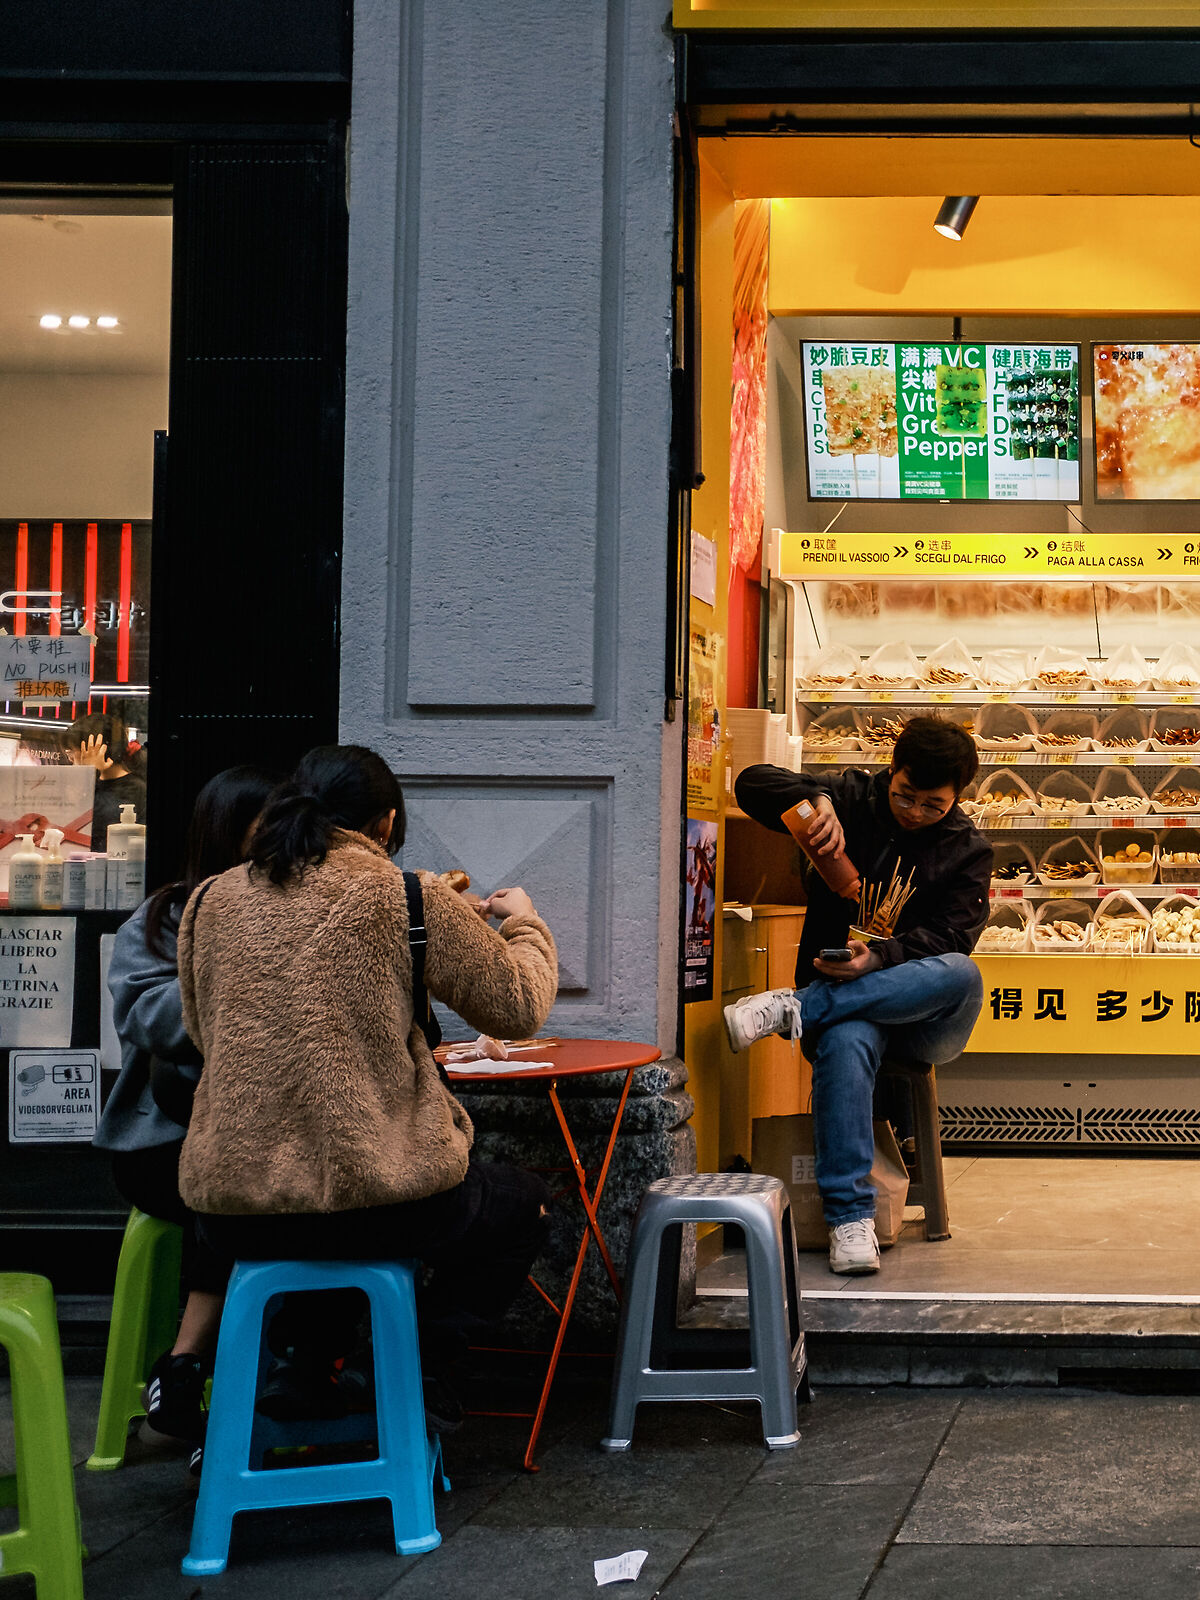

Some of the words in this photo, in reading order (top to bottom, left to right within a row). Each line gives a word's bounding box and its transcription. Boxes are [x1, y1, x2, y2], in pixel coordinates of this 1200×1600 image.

[809, 346, 889, 367] 妙脆豆皮
[900, 347, 980, 368] 满满VC
[992, 348, 1072, 370] 健康海带
[902, 392, 936, 412] Vit
[902, 414, 938, 435] Gre
[904, 437, 987, 461] Pepper
[814, 538, 837, 550] 取筐
[928, 540, 952, 552] 选串
[1061, 540, 1086, 552] 结账
[803, 552, 837, 562] PRENDI
[839, 553, 847, 562] IL
[849, 553, 890, 563] VASSOIO
[915, 553, 951, 563] SCEGLI
[954, 553, 973, 564] DAL
[975, 554, 1006, 565] FRIGO
[1047, 556, 1075, 566] PAGA
[1078, 557, 1105, 567] ALLA
[1108, 557, 1144, 567] CASSA
[9, 637, 72, 658] 不要推
[5, 663, 26, 678] NO
[1, 945, 57, 957] LIBERO
[18, 963, 37, 974] LA
[0, 980, 59, 991] ETRINA
[990, 987, 1067, 1020] 得见
[64, 1088, 90, 1099] AREA
[18, 1104, 93, 1114] VIDEOSORVEGLIATA
